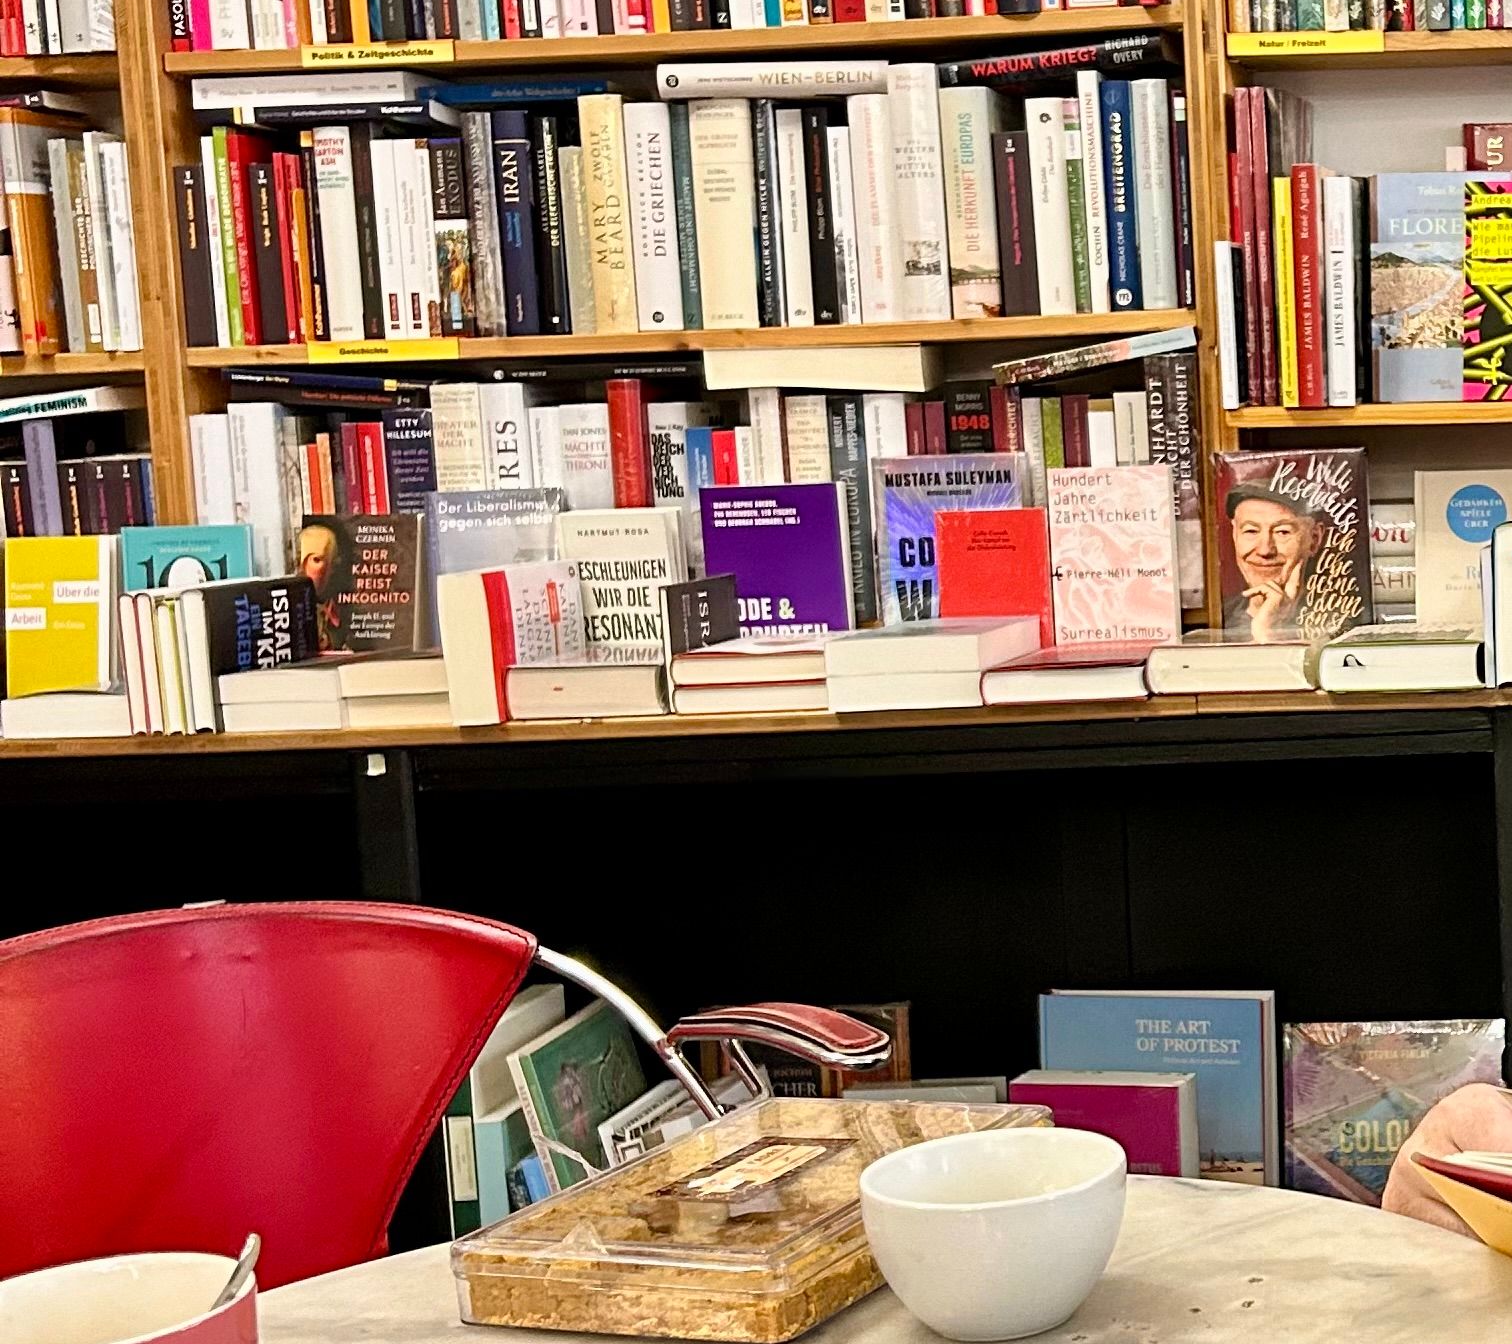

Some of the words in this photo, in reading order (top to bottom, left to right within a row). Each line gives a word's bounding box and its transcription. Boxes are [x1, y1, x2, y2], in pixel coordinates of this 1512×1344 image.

[1259, 40, 1285, 48] Natur
[1292, 39, 1326, 47] Freizeit
[311, 51, 342, 62] Politik
[356, 48, 434, 60] Zeitgeschichte
[971, 55, 1034, 77] WARUM
[1038, 48, 1097, 68] KRIEG?
[1112, 49, 1143, 64] OVERY
[1110, 111, 1127, 213] BREITENGRAD
[501, 150, 520, 203] IRAN
[650, 132, 666, 230] GRIECHEN
[961, 168, 979, 228] HERKUNFT
[594, 202, 609, 265] MARY
[610, 194, 625, 271] BEARD
[654, 234, 667, 257] DIE
[967, 231, 980, 252] DIE
[34, 396, 88, 413] FEMINISM
[950, 415, 990, 431] 1948
[884, 471, 940, 488] MUSTAFA
[946, 468, 1013, 486] SULEYMAN
[1052, 472, 1113, 487] Hundert
[1053, 491, 1097, 506] Jahre
[438, 501, 462, 514] Der
[1054, 509, 1158, 525] Zärtlichkeit
[357, 525, 394, 535] MONIKA
[577, 528, 621, 538] HARTMUT
[624, 527, 650, 536] ROSA
[355, 534, 396, 544] CZERNIN
[362, 549, 388, 561] DER
[352, 563, 398, 575] KAISER
[56, 585, 82, 598] Über
[83, 585, 100, 598] die
[356, 578, 392, 590] REIST
[337, 592, 410, 605] INKOGNITO
[592, 589, 622, 608] WIR
[627, 587, 651, 607] DIE
[11, 612, 42, 625] Arbeit
[1135, 1019, 1172, 1035] THE
[1176, 1019, 1211, 1036] ART
[1136, 1037, 1160, 1052] OF
[1163, 1038, 1241, 1054] PROTEST
